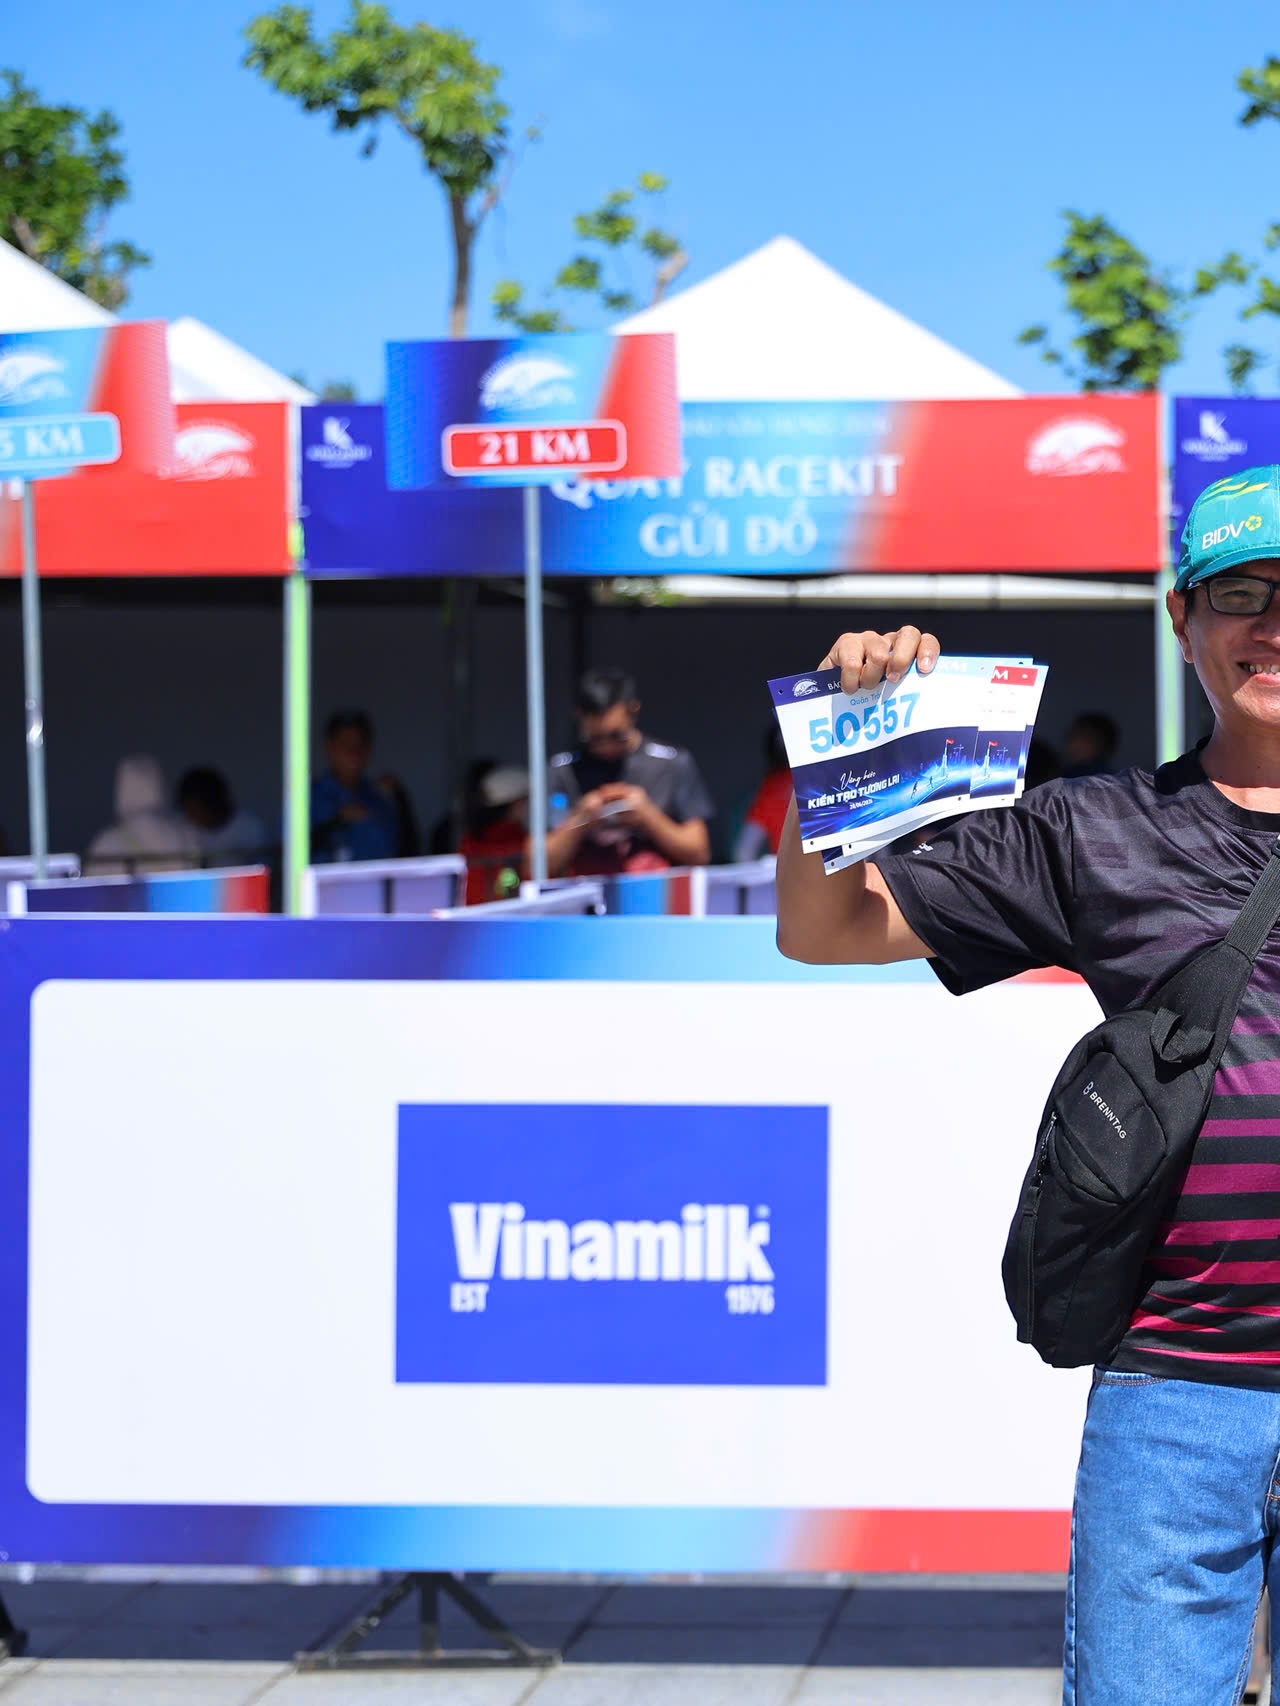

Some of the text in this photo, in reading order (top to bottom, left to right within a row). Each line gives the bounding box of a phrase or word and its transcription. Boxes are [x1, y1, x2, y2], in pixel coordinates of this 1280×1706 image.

[26, 426, 84, 457] KM
[480, 430, 593, 464] 21 KM
[703, 456, 903, 498] RACEKIT
[1202, 521, 1245, 550] BIDV
[809, 692, 921, 753] 50557
[1089, 1091, 1127, 1139] BRENNTAG
[449, 1202, 775, 1281] Vinamilk
[450, 1282, 775, 1314] EST 1976
